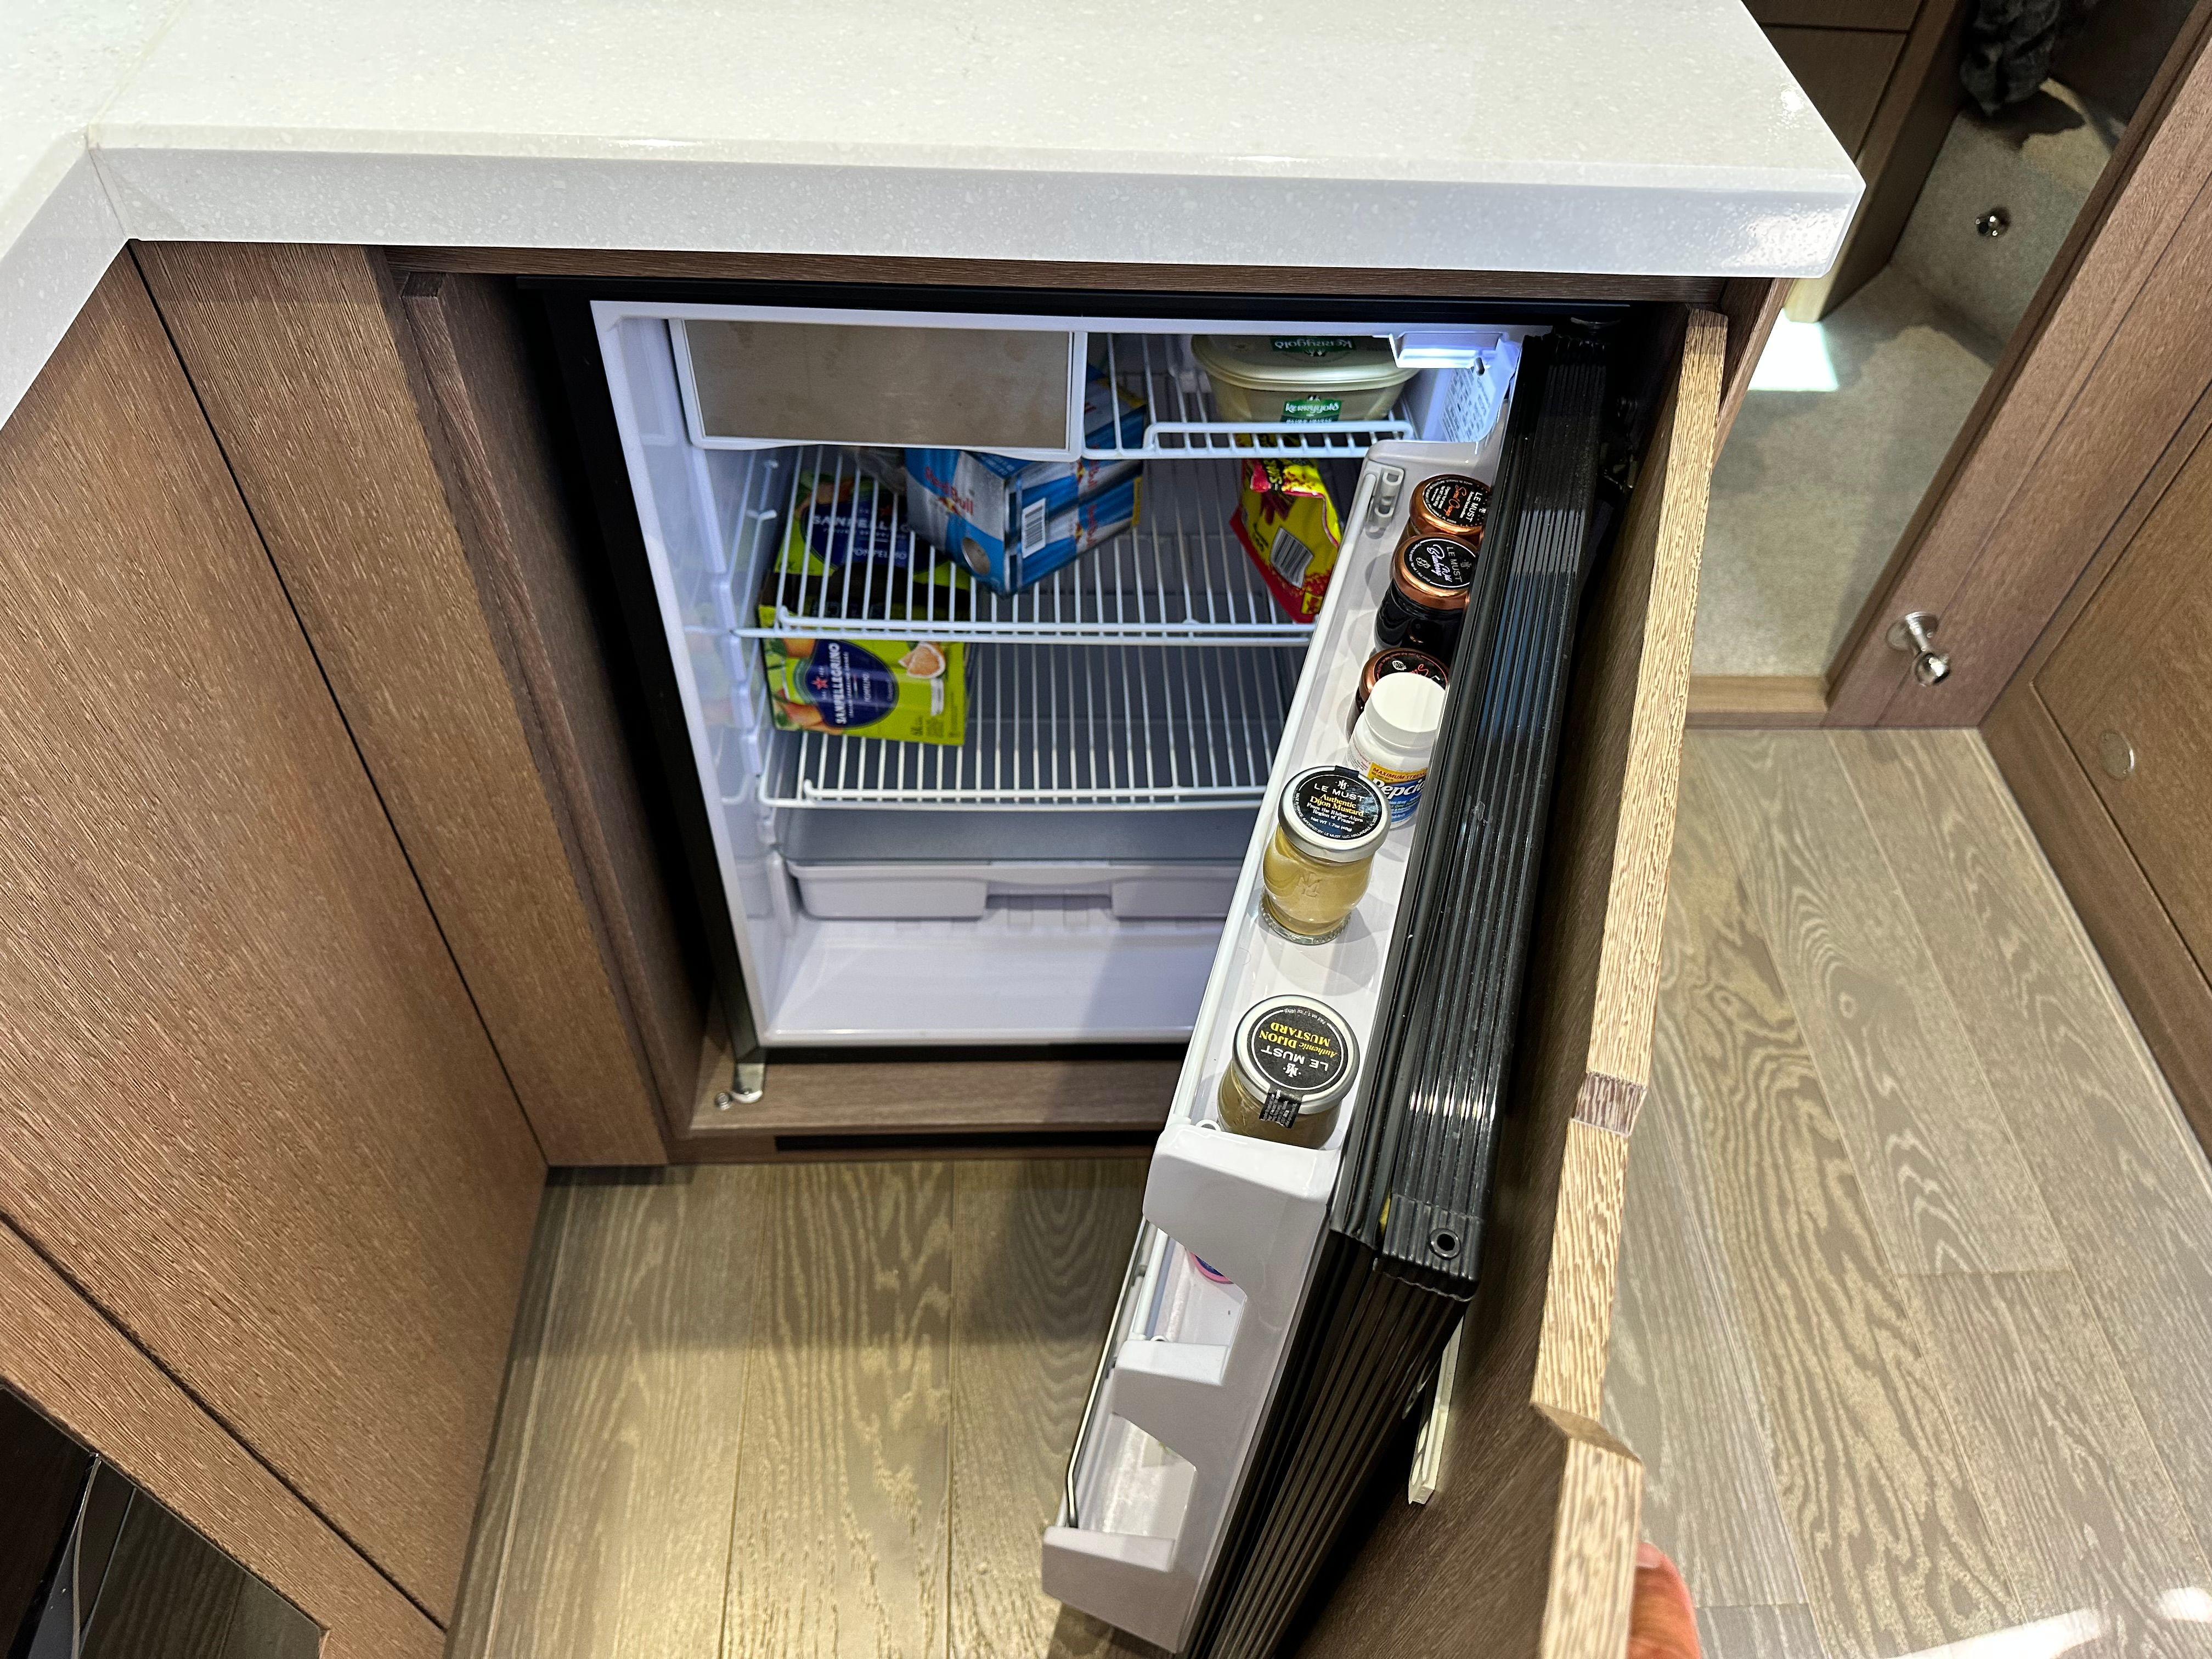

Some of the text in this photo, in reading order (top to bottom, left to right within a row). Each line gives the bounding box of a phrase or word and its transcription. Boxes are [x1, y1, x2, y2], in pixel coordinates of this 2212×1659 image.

[1285, 402, 1340, 414] Kerrygold
[1473, 492, 1483, 502] LE
[1465, 502, 1479, 523] MUST
[1447, 546, 1463, 583] LE MUST
[828, 642, 847, 724] SANPELLEGRINO
[1372, 768, 1405, 780] MAXIMUM
[1314, 783, 1364, 802] LE MUST
[1320, 794, 1357, 809] Authentic
[1307, 802, 1320, 811] From
[1310, 796, 1364, 817] Dijon Mustard
[1312, 810, 1330, 819] Region
[1337, 816, 1355, 825] France
[1259, 1030, 1338, 1059] Authentic DIJON
[1270, 1022, 1331, 1047] MUSTARD
[1261, 1045, 1329, 1071] LE MUST
